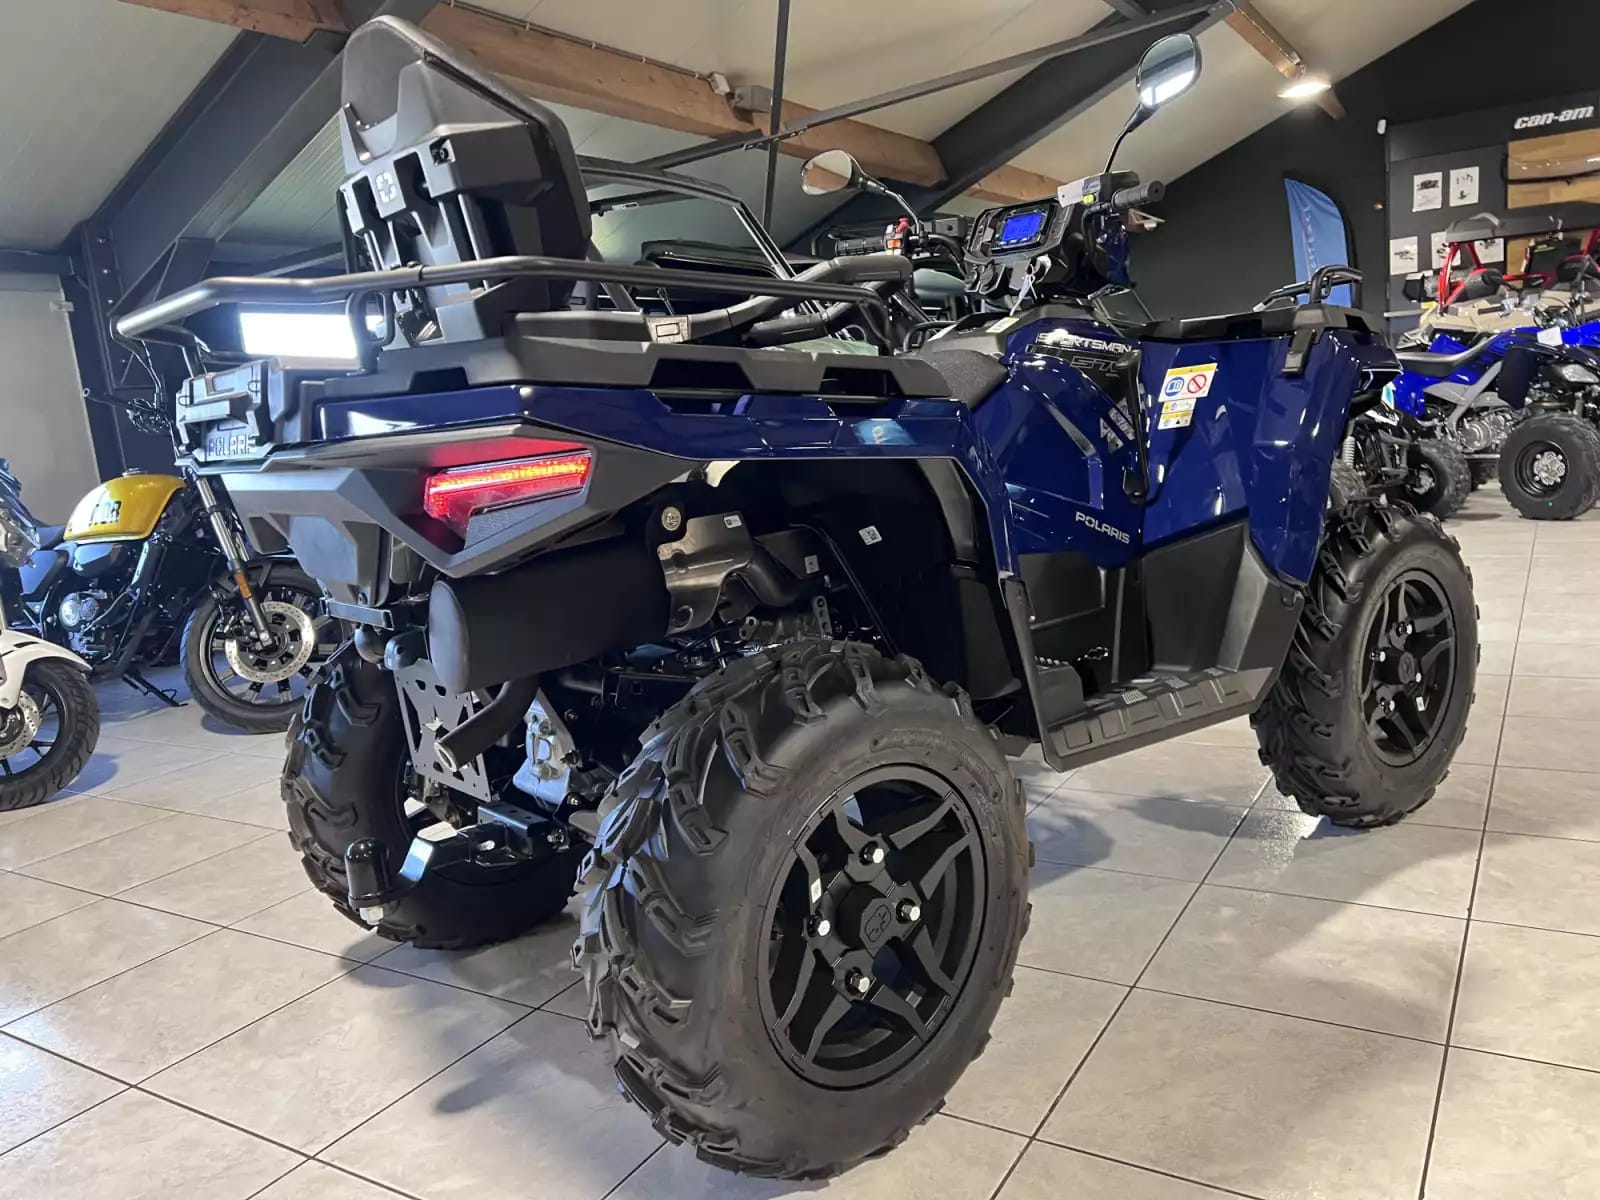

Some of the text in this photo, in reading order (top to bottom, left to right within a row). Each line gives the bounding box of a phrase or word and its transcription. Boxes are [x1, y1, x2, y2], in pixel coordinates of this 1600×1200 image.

[1513, 106, 1595, 130] can-am
[1070, 355, 1118, 373] 57
[1075, 511, 1130, 544] POLARIS
